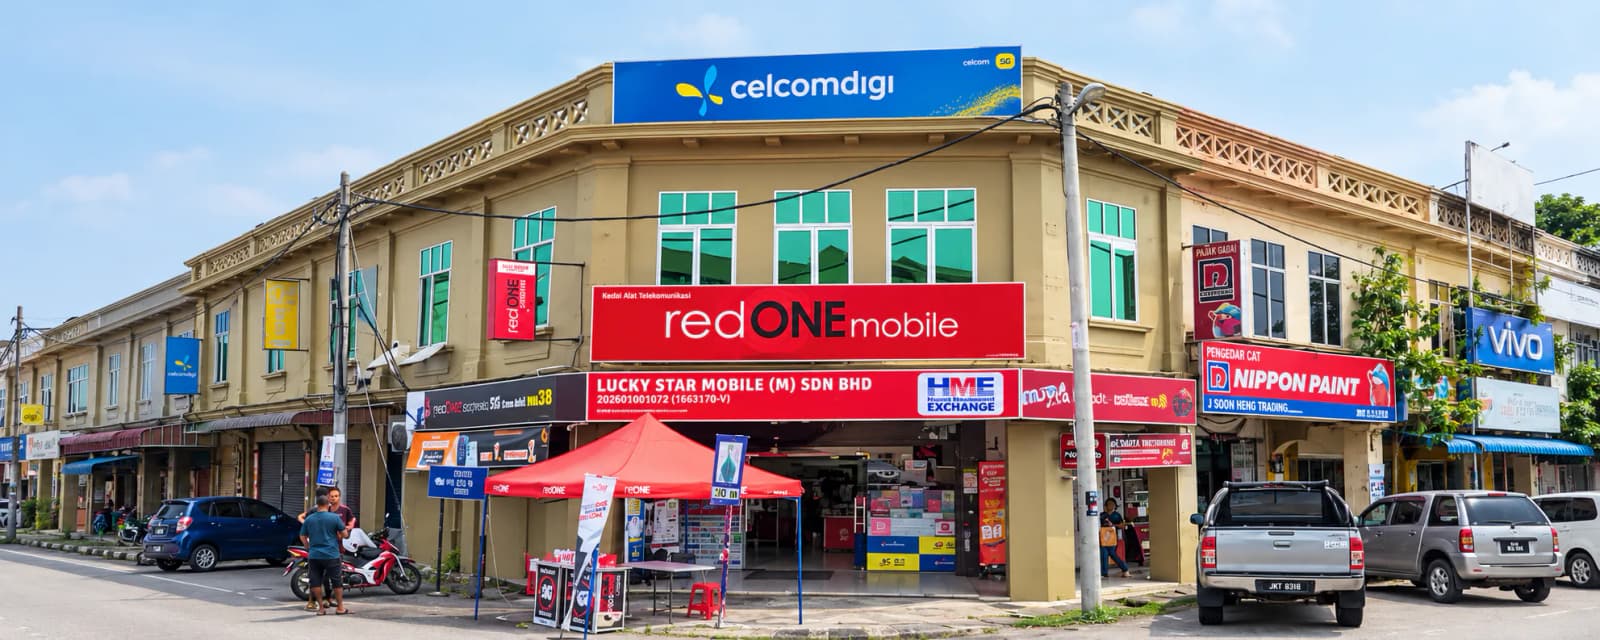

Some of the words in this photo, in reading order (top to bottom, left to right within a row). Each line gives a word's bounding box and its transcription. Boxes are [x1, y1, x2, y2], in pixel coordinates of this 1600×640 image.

[962, 58, 990, 67] celcom
[730, 71, 893, 101] celcomdigi
[623, 292, 638, 300] Alat
[638, 291, 691, 300] Telekomunikasi
[850, 312, 957, 339] mobile
[1488, 321, 1543, 361] vivo
[1206, 346, 1245, 361] PENGEDAR
[1247, 351, 1262, 362] CAT
[597, 378, 650, 392] LUCKY
[655, 378, 697, 392] STAR
[701, 378, 764, 391] MOBILE
[768, 377, 796, 392] (M)
[801, 377, 834, 391] SDN
[839, 376, 873, 390] BHD
[927, 377, 995, 397] HME
[1233, 368, 1307, 393] NIPPON
[1308, 374, 1360, 397] PAINT
[597, 394, 669, 405] 202601001072
[927, 402, 995, 412] EXCHANGE
[1207, 398, 1212, 409] J
[1213, 398, 1235, 410] SOON
[1236, 400, 1256, 411] HENG
